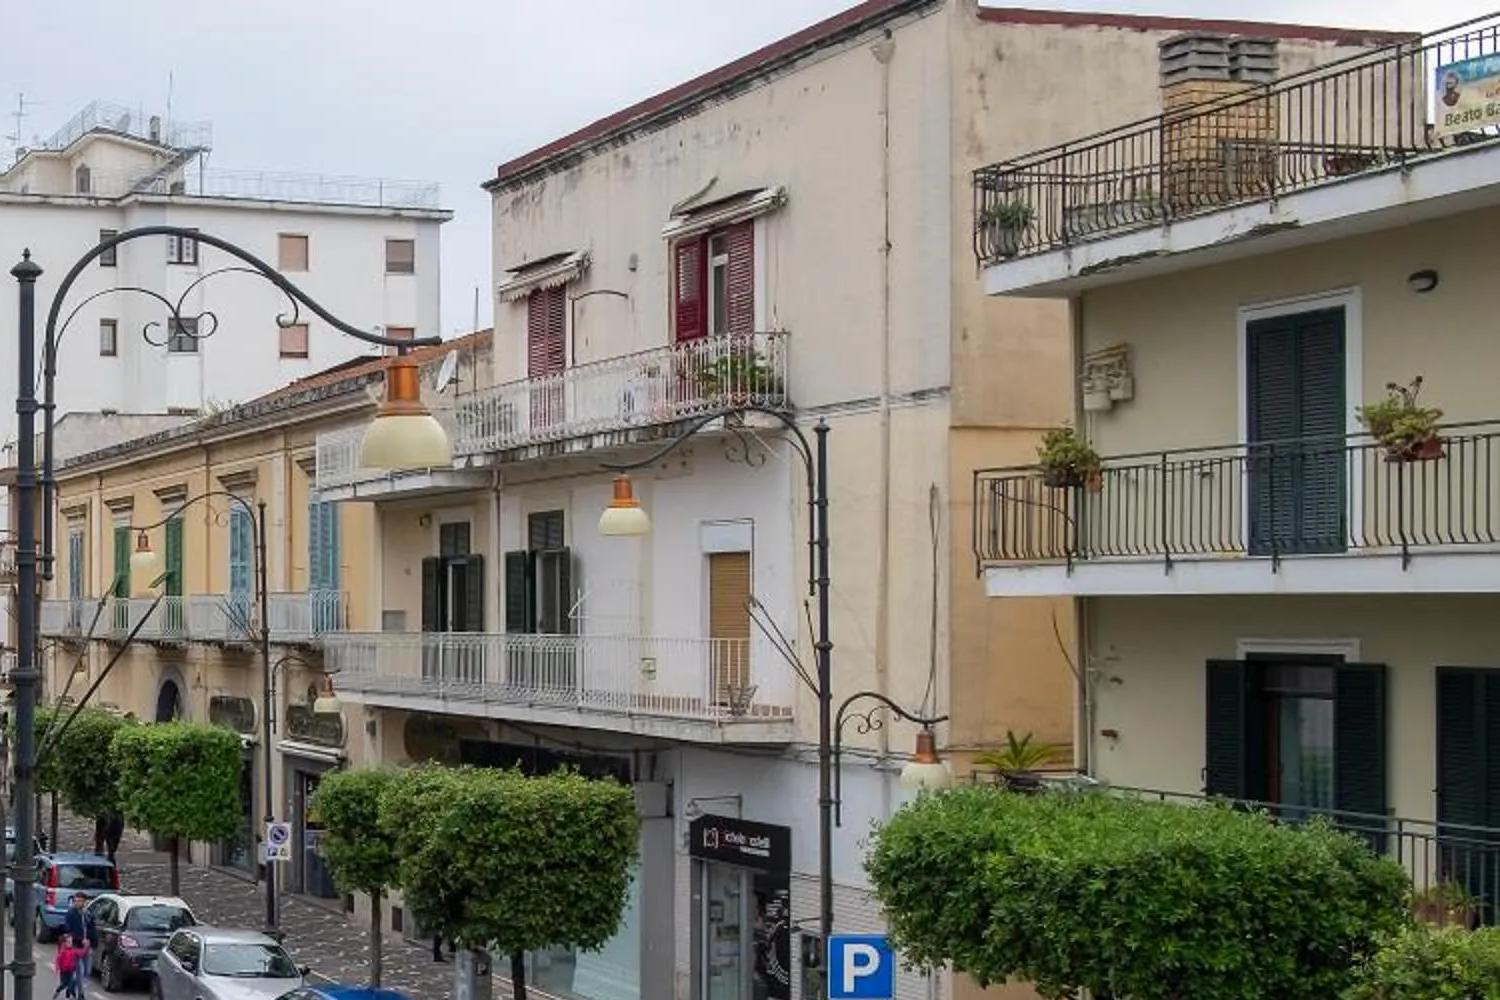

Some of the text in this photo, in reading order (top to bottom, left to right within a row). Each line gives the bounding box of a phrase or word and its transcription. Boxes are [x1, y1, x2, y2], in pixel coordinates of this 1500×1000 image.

[1444, 108, 1483, 127] Beato
[477, 963, 487, 975] P
[843, 943, 881, 993] P
